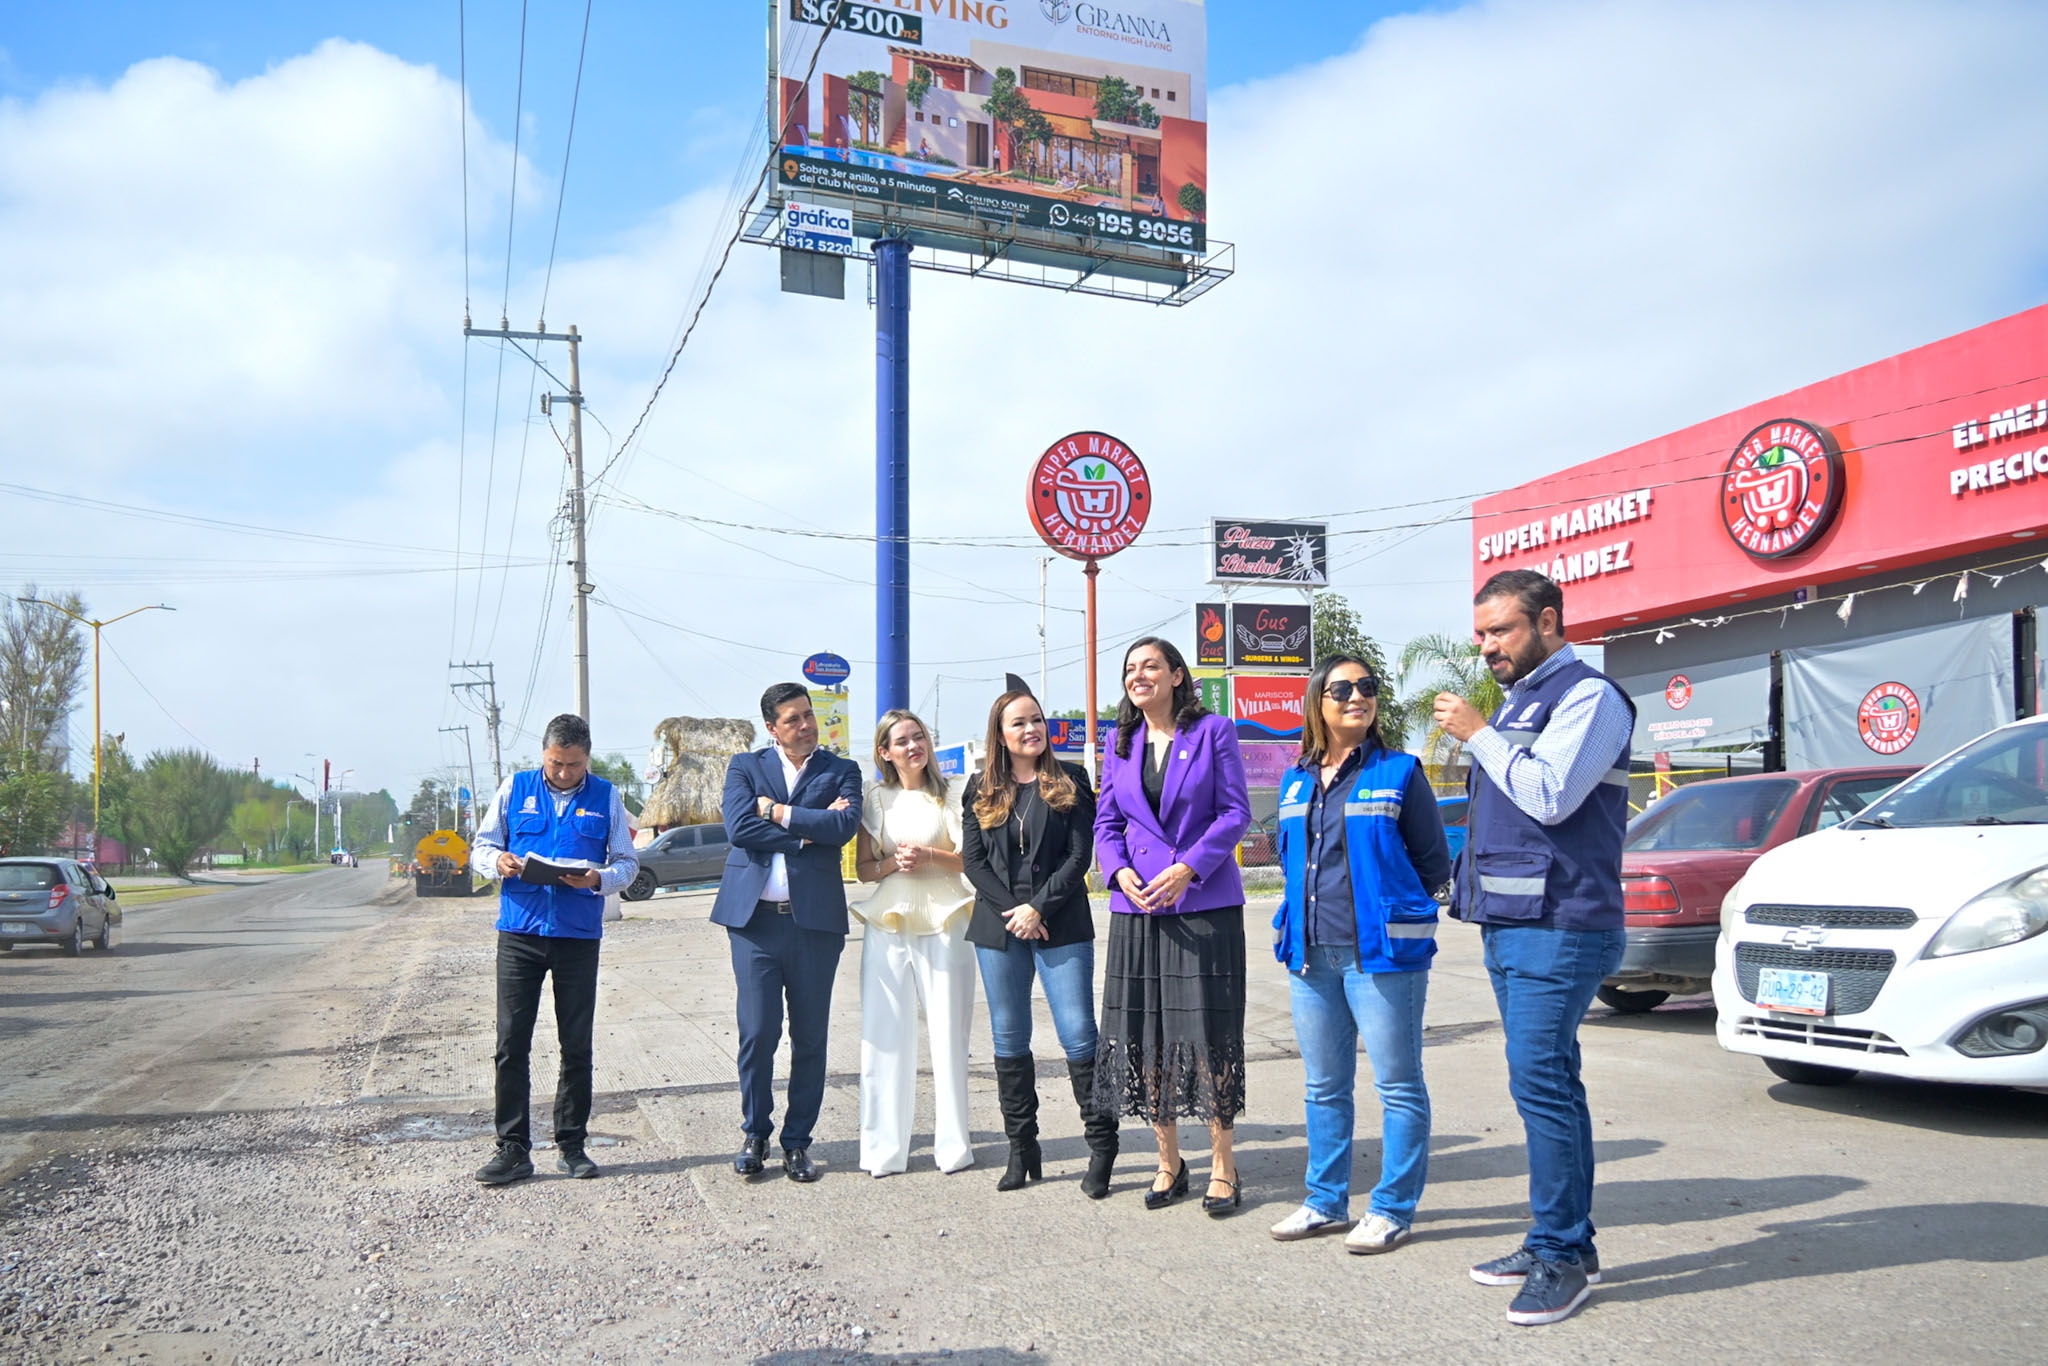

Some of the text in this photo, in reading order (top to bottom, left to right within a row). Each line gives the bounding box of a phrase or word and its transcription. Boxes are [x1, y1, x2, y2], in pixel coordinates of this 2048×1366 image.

[1075, 2, 1171, 42] GRANNA
[1076, 25, 1173, 53] ENTORNO HIGH LIVING
[799, 162, 829, 176] Sobre
[831, 168, 847, 179] 3er
[880, 178, 887, 186] a
[888, 177, 895, 187] 5
[896, 179, 937, 194] minutos
[799, 173, 815, 184] del
[817, 176, 841, 188] Club
[787, 209, 850, 231] gráfica
[1097, 211, 1134, 236] 195
[1138, 219, 1193, 246] 9056
[787, 235, 852, 256] 912 5220
[1952, 419, 1984, 449] EL
[1040, 437, 1145, 486] SUPER MARKET
[1479, 488, 1652, 562] SUPER MARKET
[1216, 553, 1283, 575] Libertad
[1256, 609, 1289, 631] Gus
[1200, 641, 1224, 657] Gus
[1254, 691, 1295, 699] MARISCOS
[1237, 697, 1272, 718] VILLA
[1068, 732, 1085, 742] San
